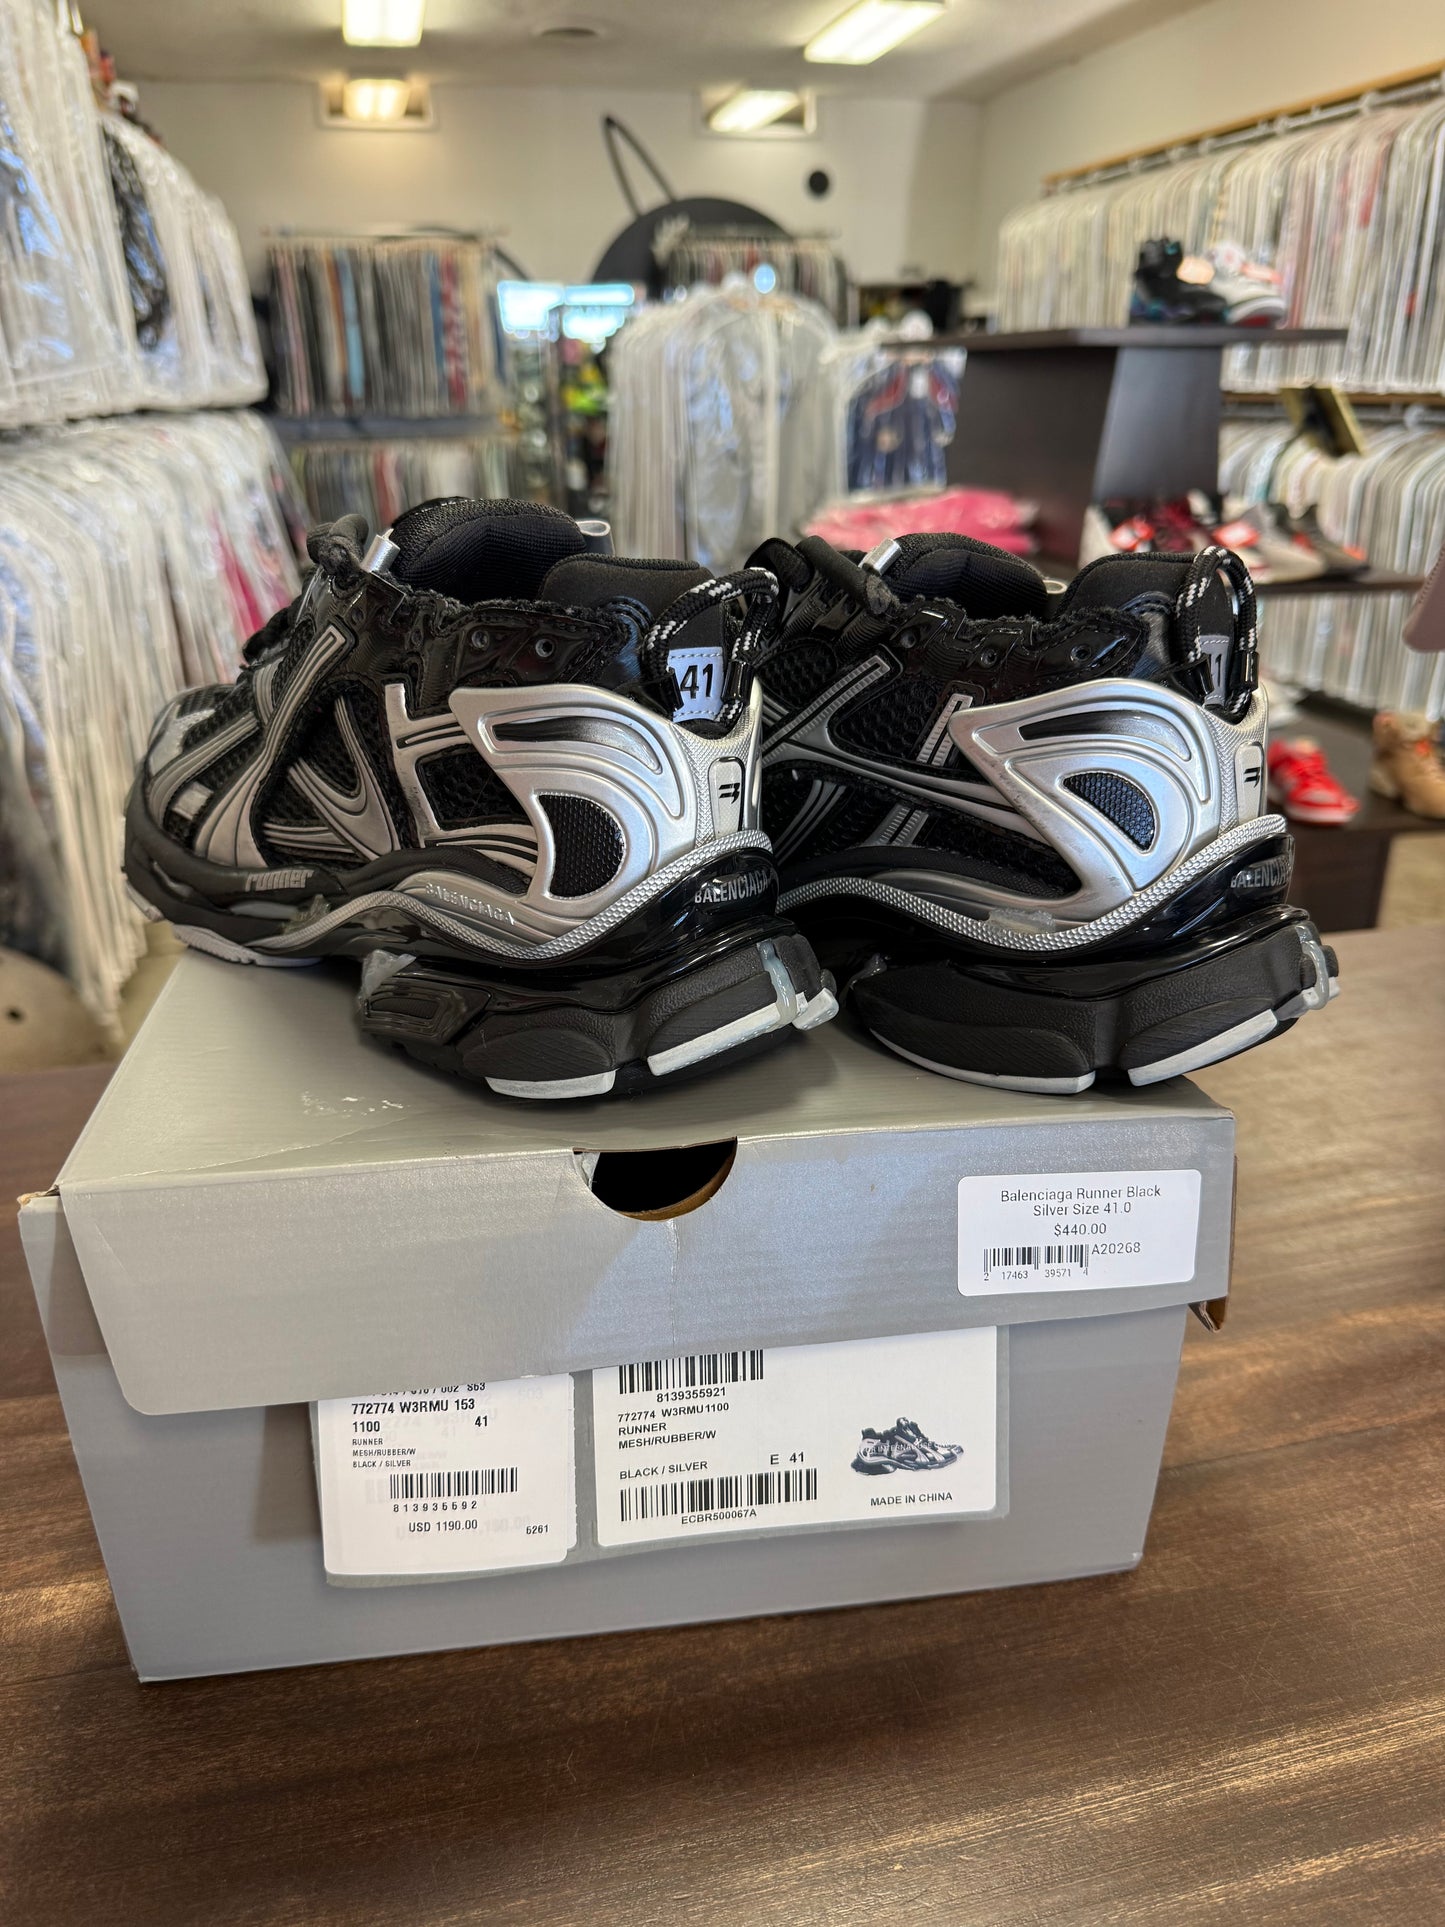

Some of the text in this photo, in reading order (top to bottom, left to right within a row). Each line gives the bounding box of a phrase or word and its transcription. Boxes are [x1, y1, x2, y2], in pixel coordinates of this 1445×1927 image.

[680, 663, 714, 699] 41
[245, 869, 314, 892] runner
[694, 869, 768, 903] BALENCIAGA
[426, 882, 515, 925] BALENCIAGA
[1001, 1185, 1161, 1203] Balenciaga Runner Black
[1033, 1202, 1131, 1216] Silver Size 41.0
[1054, 1223, 1107, 1237] $440.00
[1091, 1242, 1141, 1255] A20268
[1001, 1270, 1028, 1280] 17463
[1045, 1268, 1072, 1278] 39571
[656, 1387, 726, 1402] 8139355921
[352, 1398, 475, 1414] 772774 W3RMU 153
[618, 1410, 656, 1422] 772774
[353, 1421, 380, 1432] 1100
[474, 1415, 488, 1427] 41
[618, 1422, 667, 1436] RUNNER
[352, 1438, 383, 1446] RUNNER
[618, 1430, 717, 1449] MESH/RUBBER/W
[353, 1448, 416, 1456] MESH/RUBBER/W
[770, 1451, 804, 1465] E 41
[619, 1466, 658, 1480] BLACK
[668, 1461, 708, 1474] SILVER
[870, 1492, 953, 1506] MADE IN CHINA
[681, 1508, 757, 1524] ECBR500067A
[409, 1522, 431, 1533] USD
[436, 1519, 478, 1532] 1190.00
